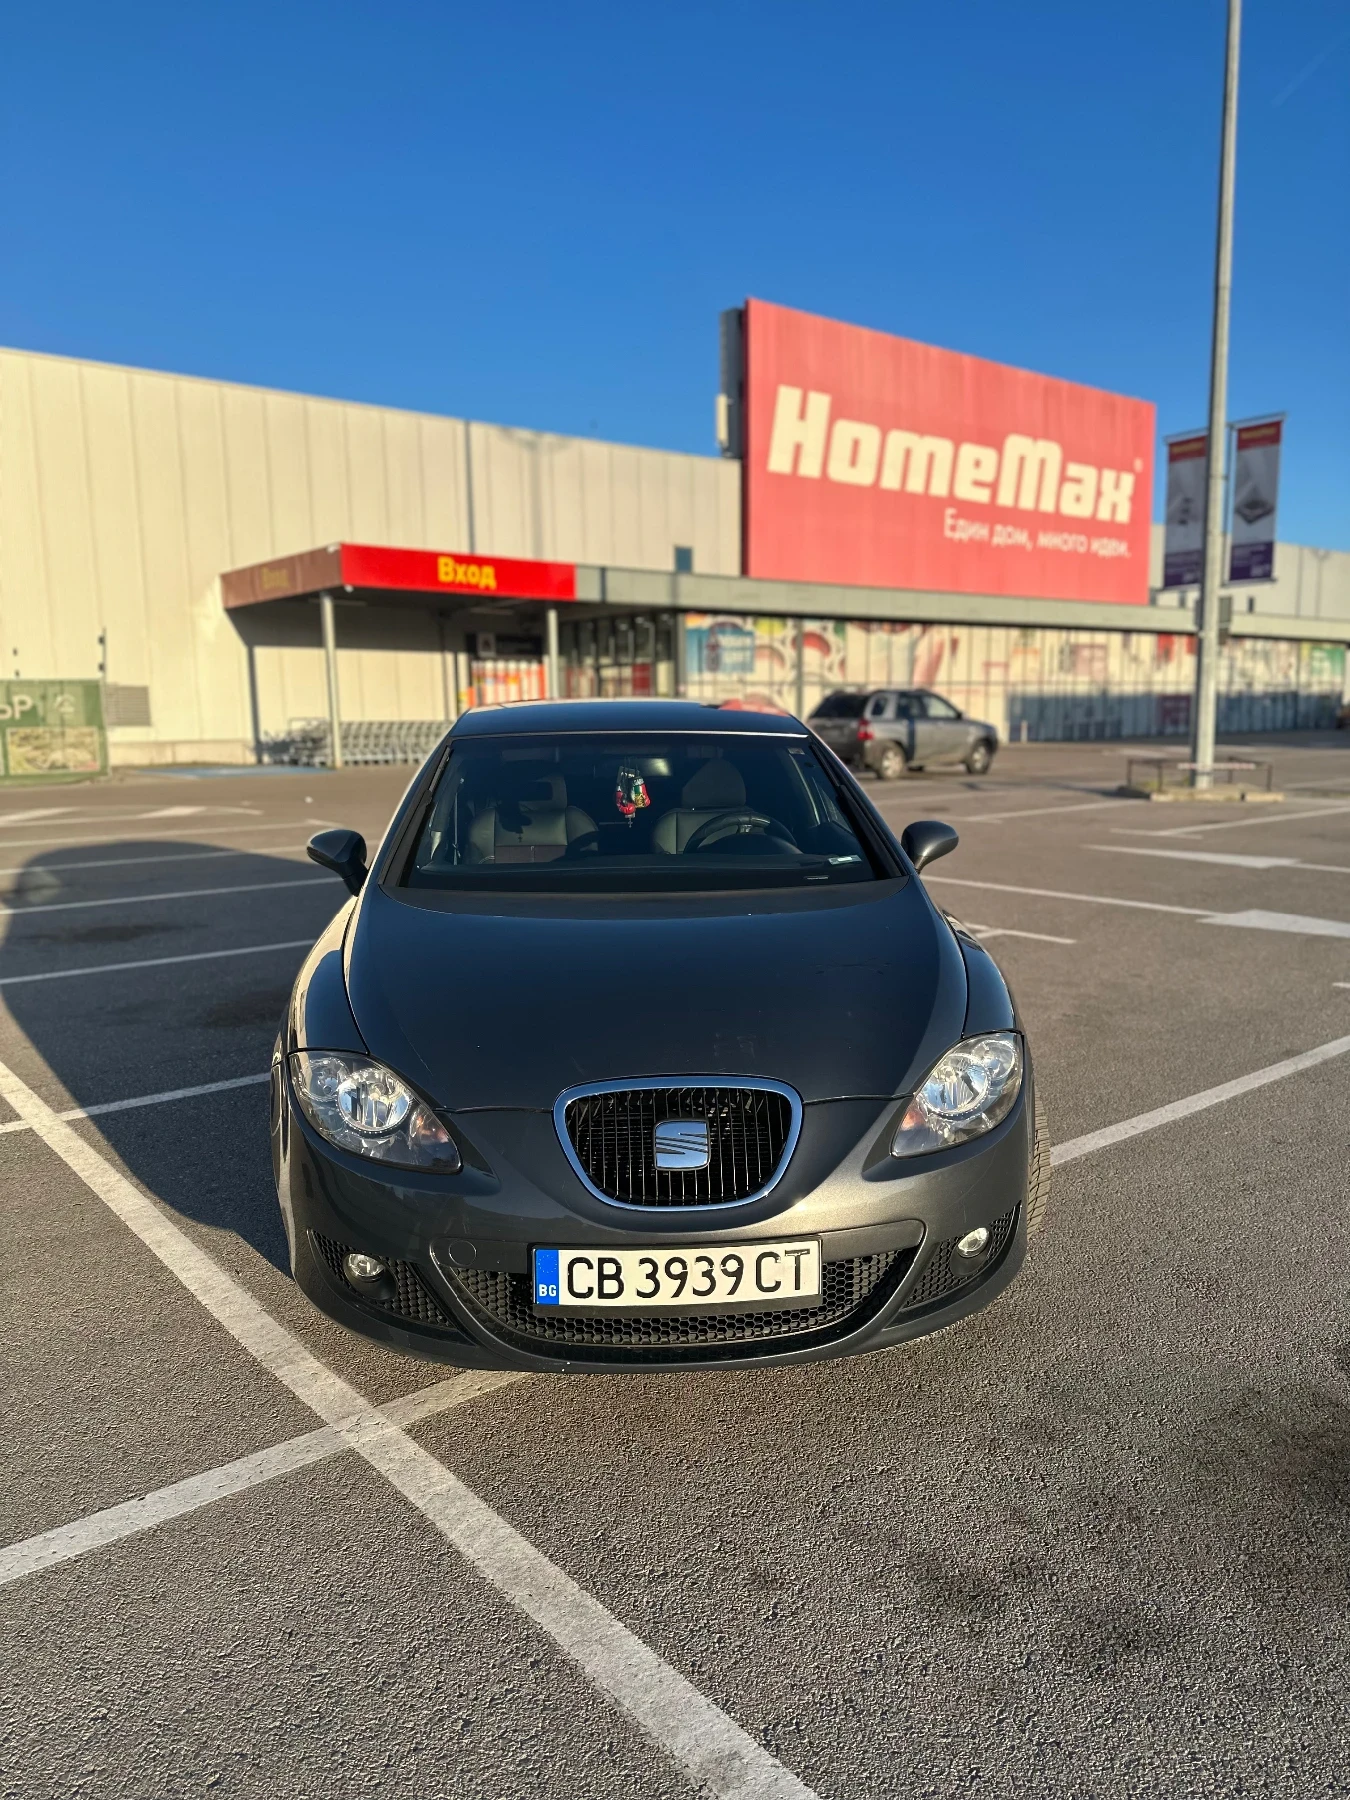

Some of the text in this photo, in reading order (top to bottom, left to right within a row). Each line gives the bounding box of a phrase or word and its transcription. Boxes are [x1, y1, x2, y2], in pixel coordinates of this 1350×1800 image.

[767, 384, 1135, 524] HomeMax
[943, 506, 990, 543] Един
[991, 523, 1033, 553] дом,
[1036, 529, 1088, 554] много
[437, 555, 496, 590] Вход
[538, 1284, 557, 1297] BG
[567, 1248, 811, 1300] CB 3939 CT
